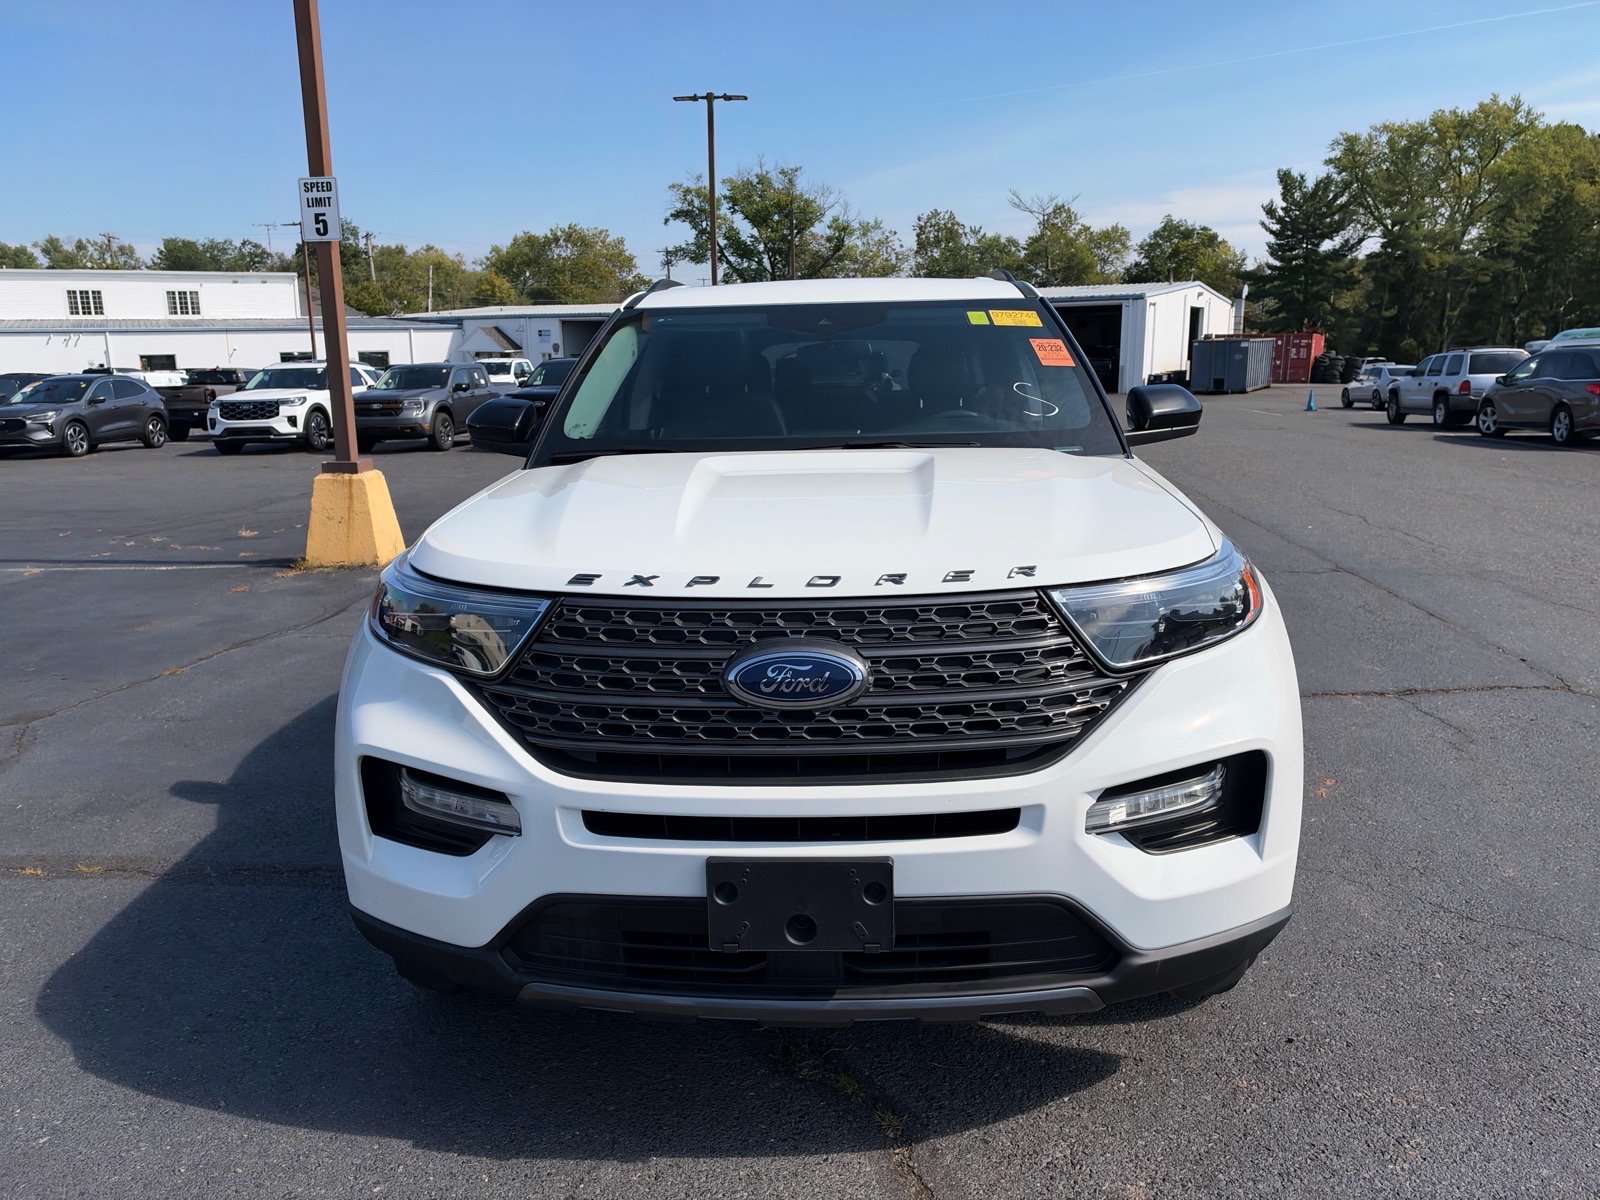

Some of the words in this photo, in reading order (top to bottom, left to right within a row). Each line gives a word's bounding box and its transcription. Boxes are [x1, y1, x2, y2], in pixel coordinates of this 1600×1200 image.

[303, 181, 332, 193] SPEED
[306, 196, 332, 208] LIMIT
[314, 212, 329, 237] 5
[565, 564, 1038, 589] EXPLORER
[760, 663, 831, 693] Ford
